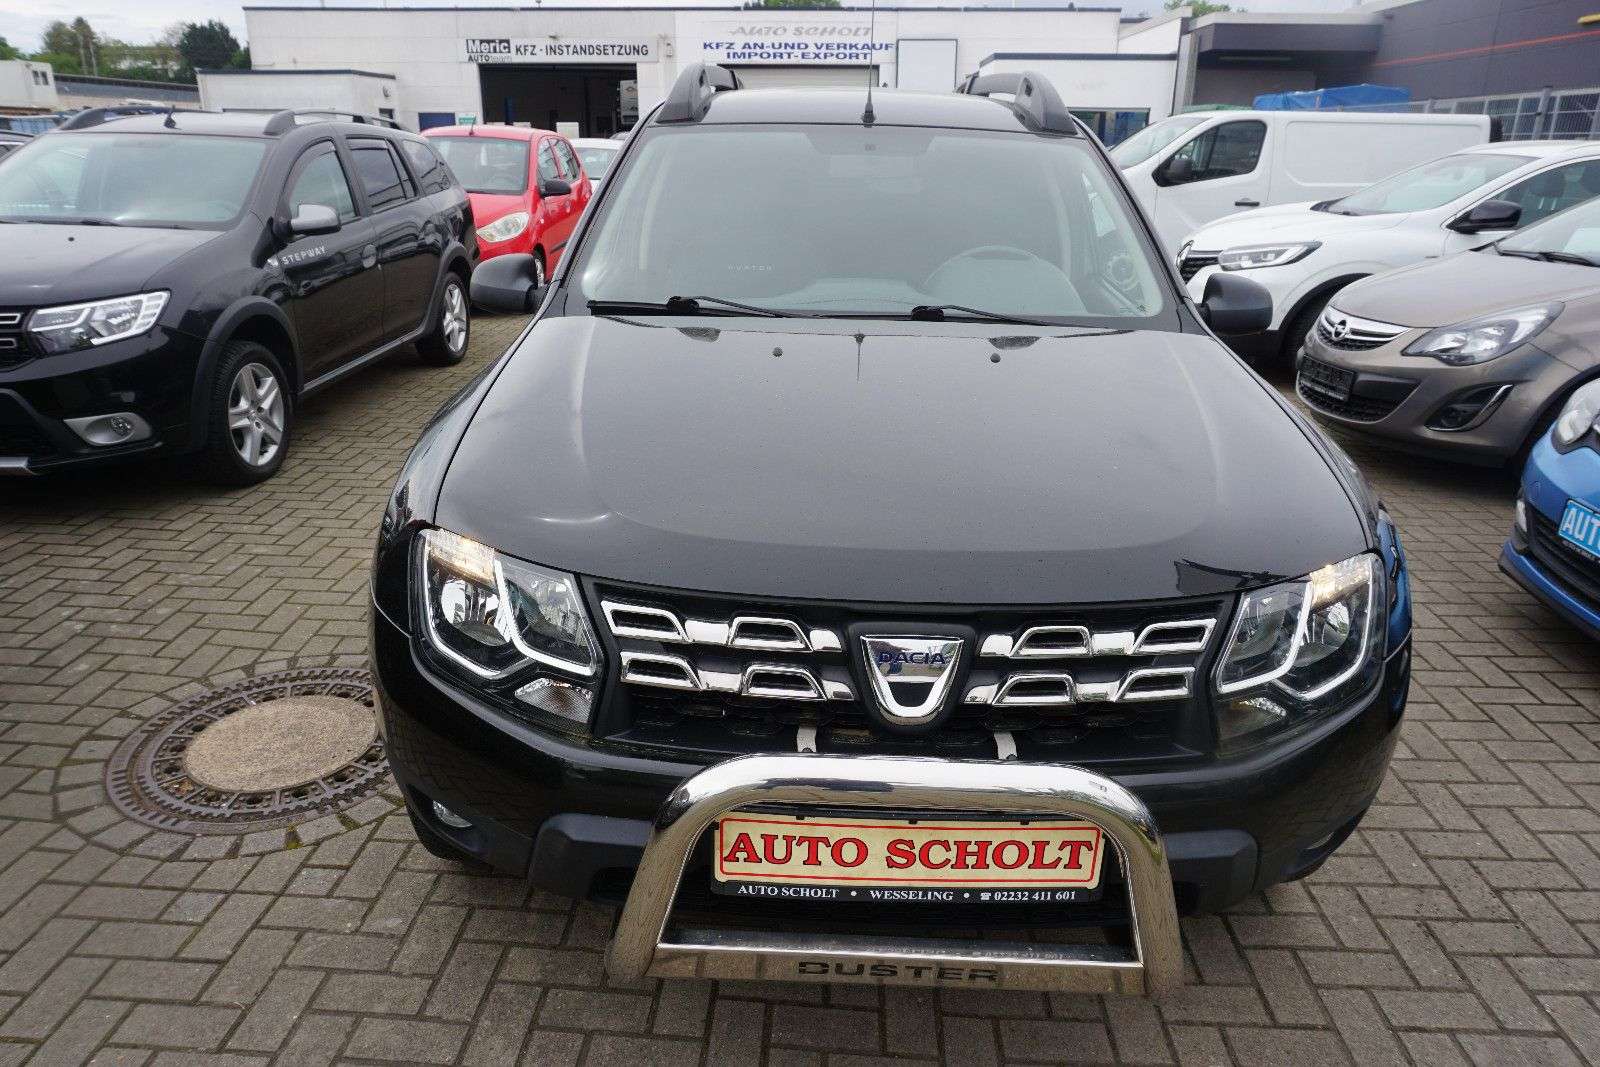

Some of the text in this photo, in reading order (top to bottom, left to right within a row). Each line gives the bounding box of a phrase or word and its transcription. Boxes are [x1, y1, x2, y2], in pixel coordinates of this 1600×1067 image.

[730, 26, 787, 36] AUTO
[466, 39, 510, 53] Meric
[515, 44, 537, 56] KFZ
[545, 44, 649, 56] INSTANDSETZUNG
[703, 42, 735, 50] KFZ
[814, 42, 896, 51] VERKAUF
[281, 245, 326, 265] STEPWAY
[1562, 507, 1600, 552] AUT
[879, 652, 945, 665] DACIA
[723, 832, 1094, 870] AUTO SCHOLT
[737, 885, 1076, 901] AUTO SCHOLT WESSELING 02232 411 601
[799, 961, 999, 983] DUSTER
